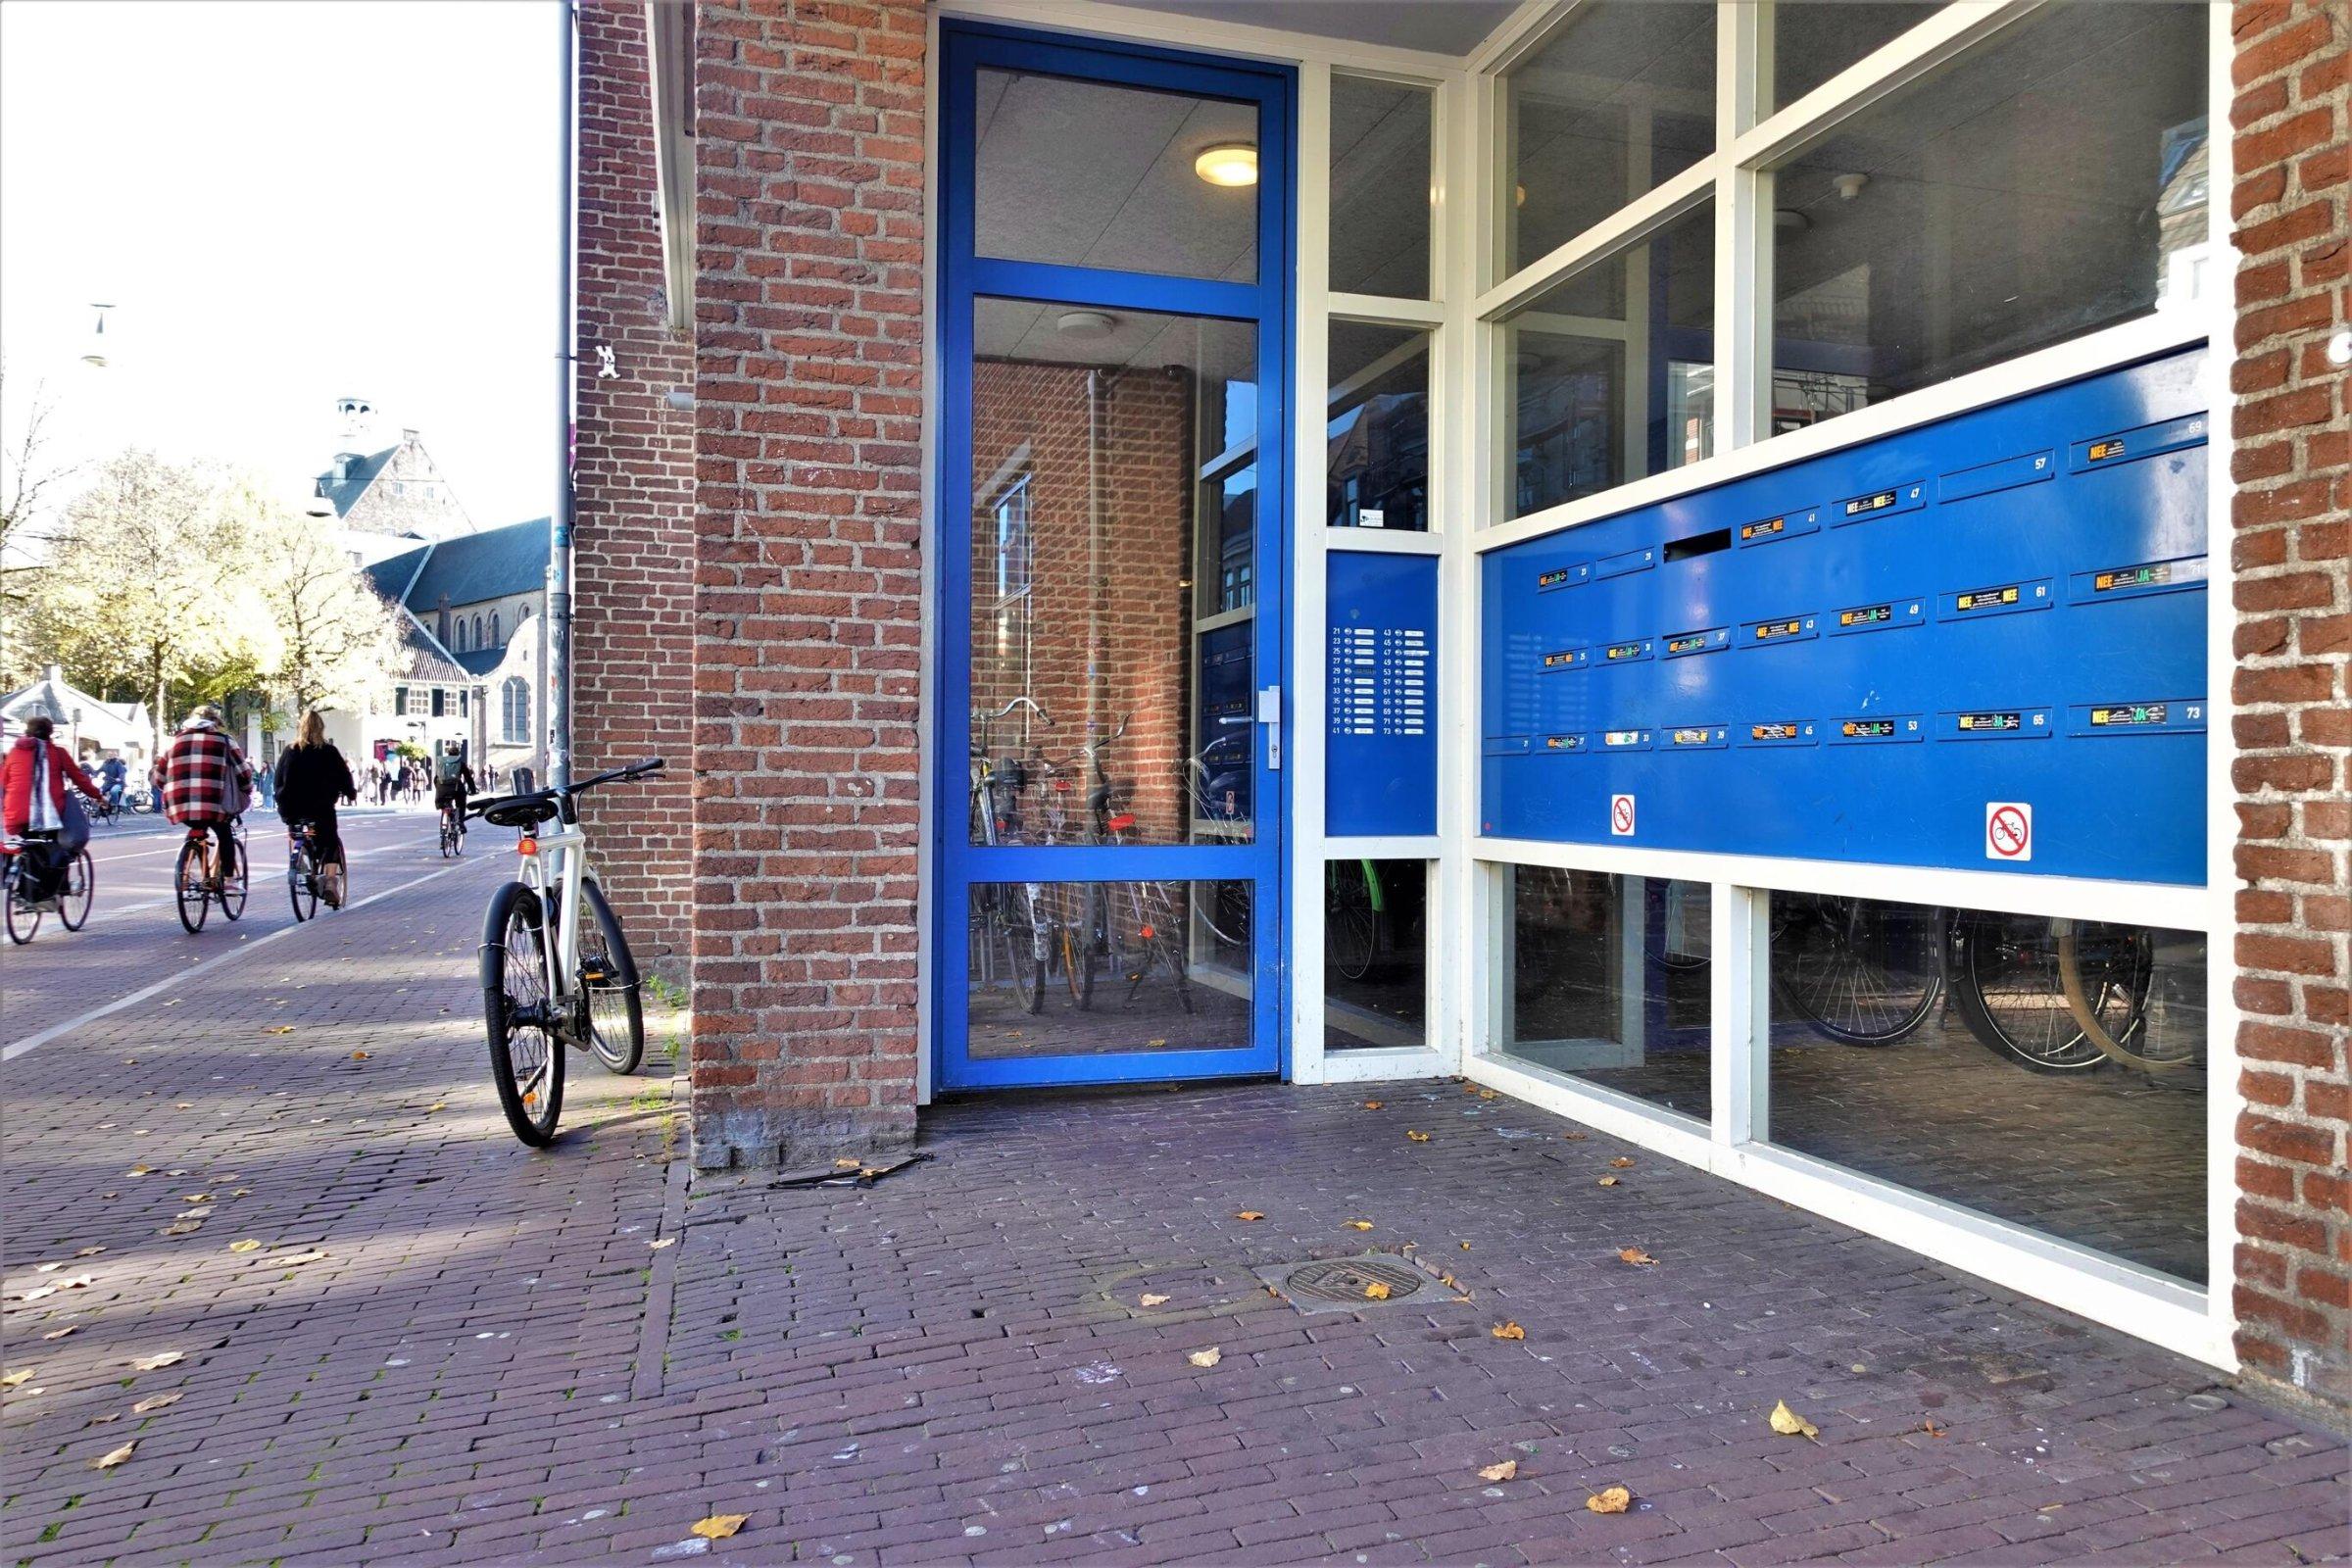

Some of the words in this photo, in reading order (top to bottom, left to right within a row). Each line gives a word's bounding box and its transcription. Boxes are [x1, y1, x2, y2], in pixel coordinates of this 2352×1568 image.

[2188, 421, 2202, 434] 69
[2089, 445, 2108, 460] NEE
[2034, 457, 2046, 470] 57
[1910, 487, 1920, 499] 47
[1846, 502, 1859, 514] NEE
[1873, 495, 1886, 509] NEE
[1808, 513, 1815, 522] 41
[2096, 575, 2113, 589] NEE
[2137, 569, 2150, 583] JA
[2035, 586, 2046, 598] 61
[1959, 596, 1973, 609] NEE
[2002, 588, 2017, 602] NEE
[1909, 604, 1919, 614] 49
[1805, 619, 1814, 629] 43
[1841, 612, 1853, 625] NEE
[1757, 626, 1768, 637] NEE
[1788, 621, 1799, 633] NEE
[2033, 713, 2044, 725] 65
[2092, 710, 2109, 723] NEE
[2133, 708, 2146, 721] JA
[2186, 707, 2201, 719] 73
[1908, 720, 1918, 731] 53
[1960, 716, 1974, 728] NEE
[1804, 725, 1813, 735] 45
